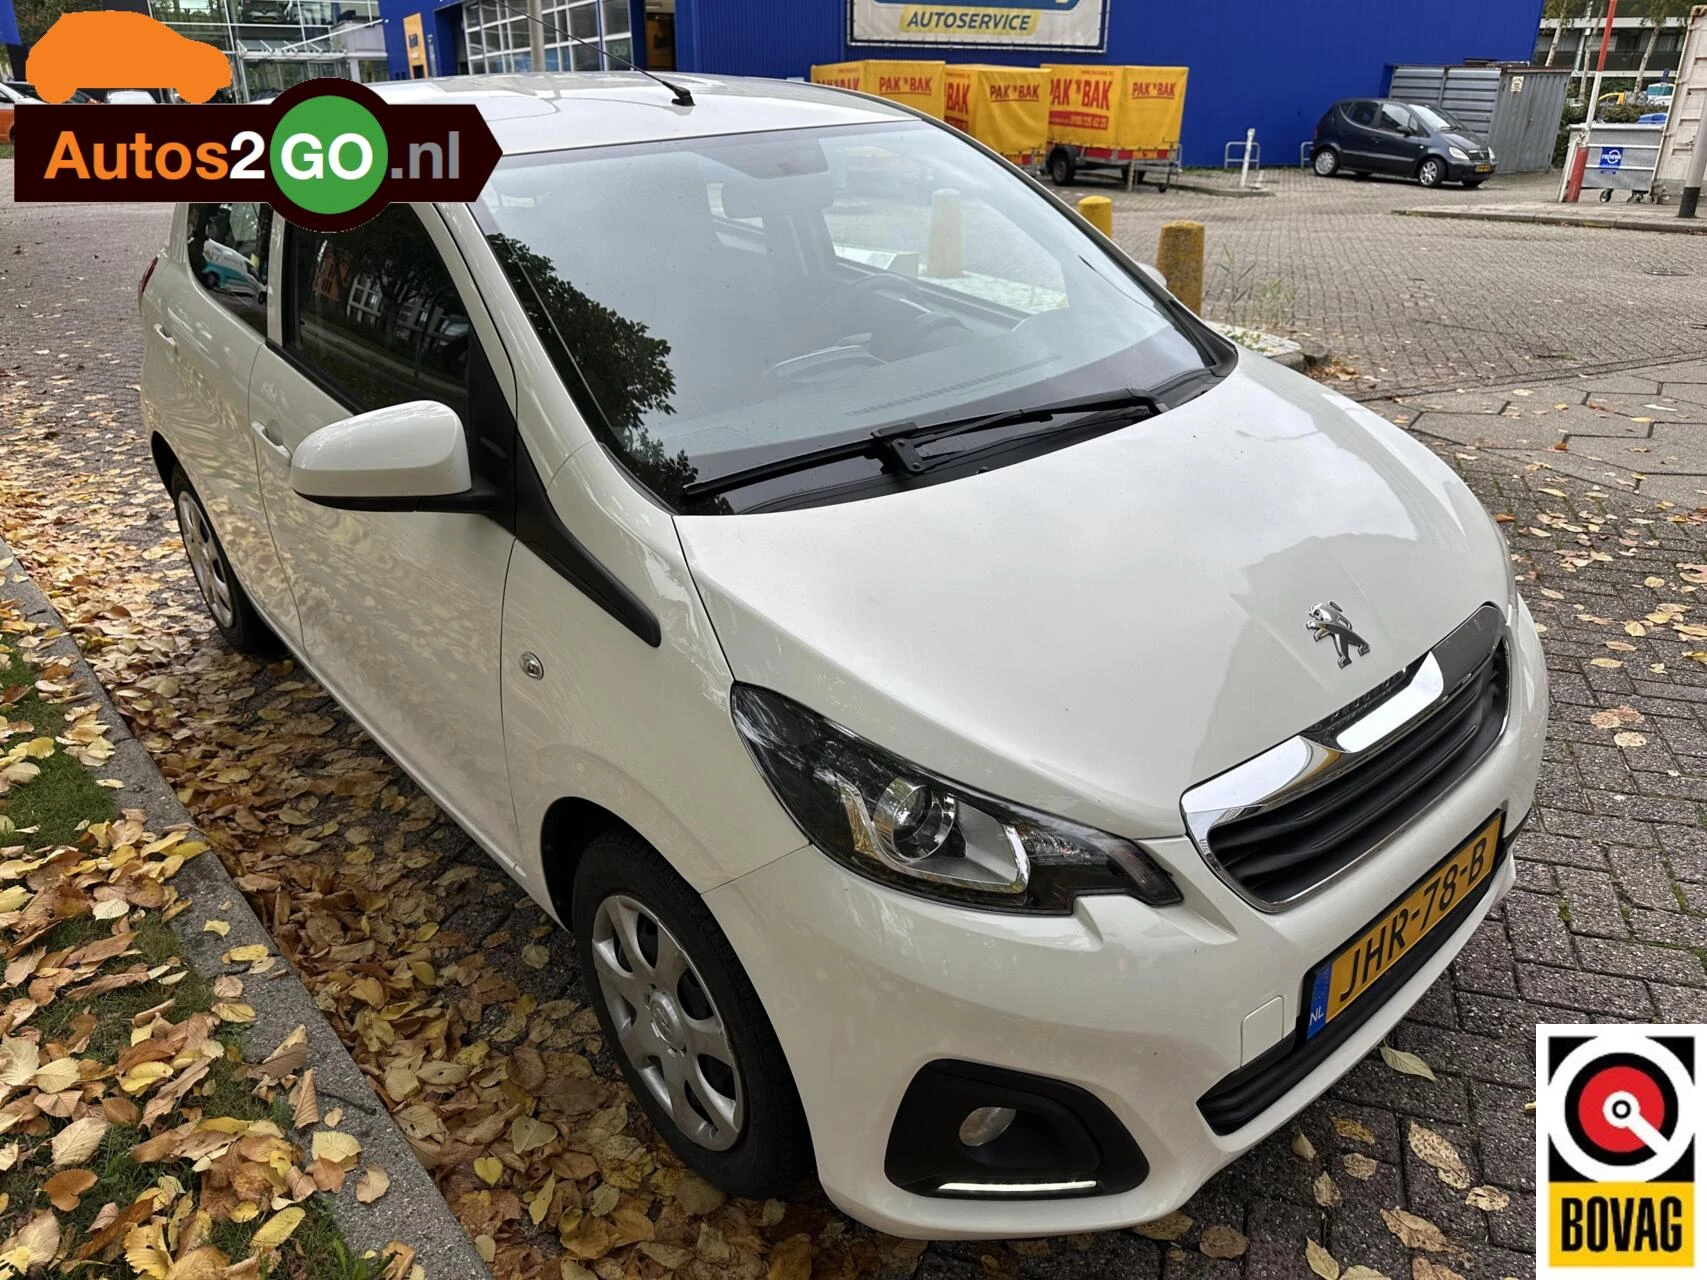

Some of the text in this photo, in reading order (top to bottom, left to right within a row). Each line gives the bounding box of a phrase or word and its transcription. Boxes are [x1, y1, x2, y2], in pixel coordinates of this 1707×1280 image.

[907, 11, 1032, 31] AUTOSERVICE
[879, 76, 901, 92] PAK
[910, 76, 933, 93] BAK
[989, 84, 1010, 99] PAK
[1018, 84, 1040, 99] BAK
[1081, 79, 1112, 110] BAK
[1132, 82, 1151, 96] PAK
[1157, 82, 1176, 97] BAK
[947, 82, 970, 115] BAK
[1339, 837, 1487, 1003] JHR-78-B
[1309, 1005, 1325, 1027] NL
